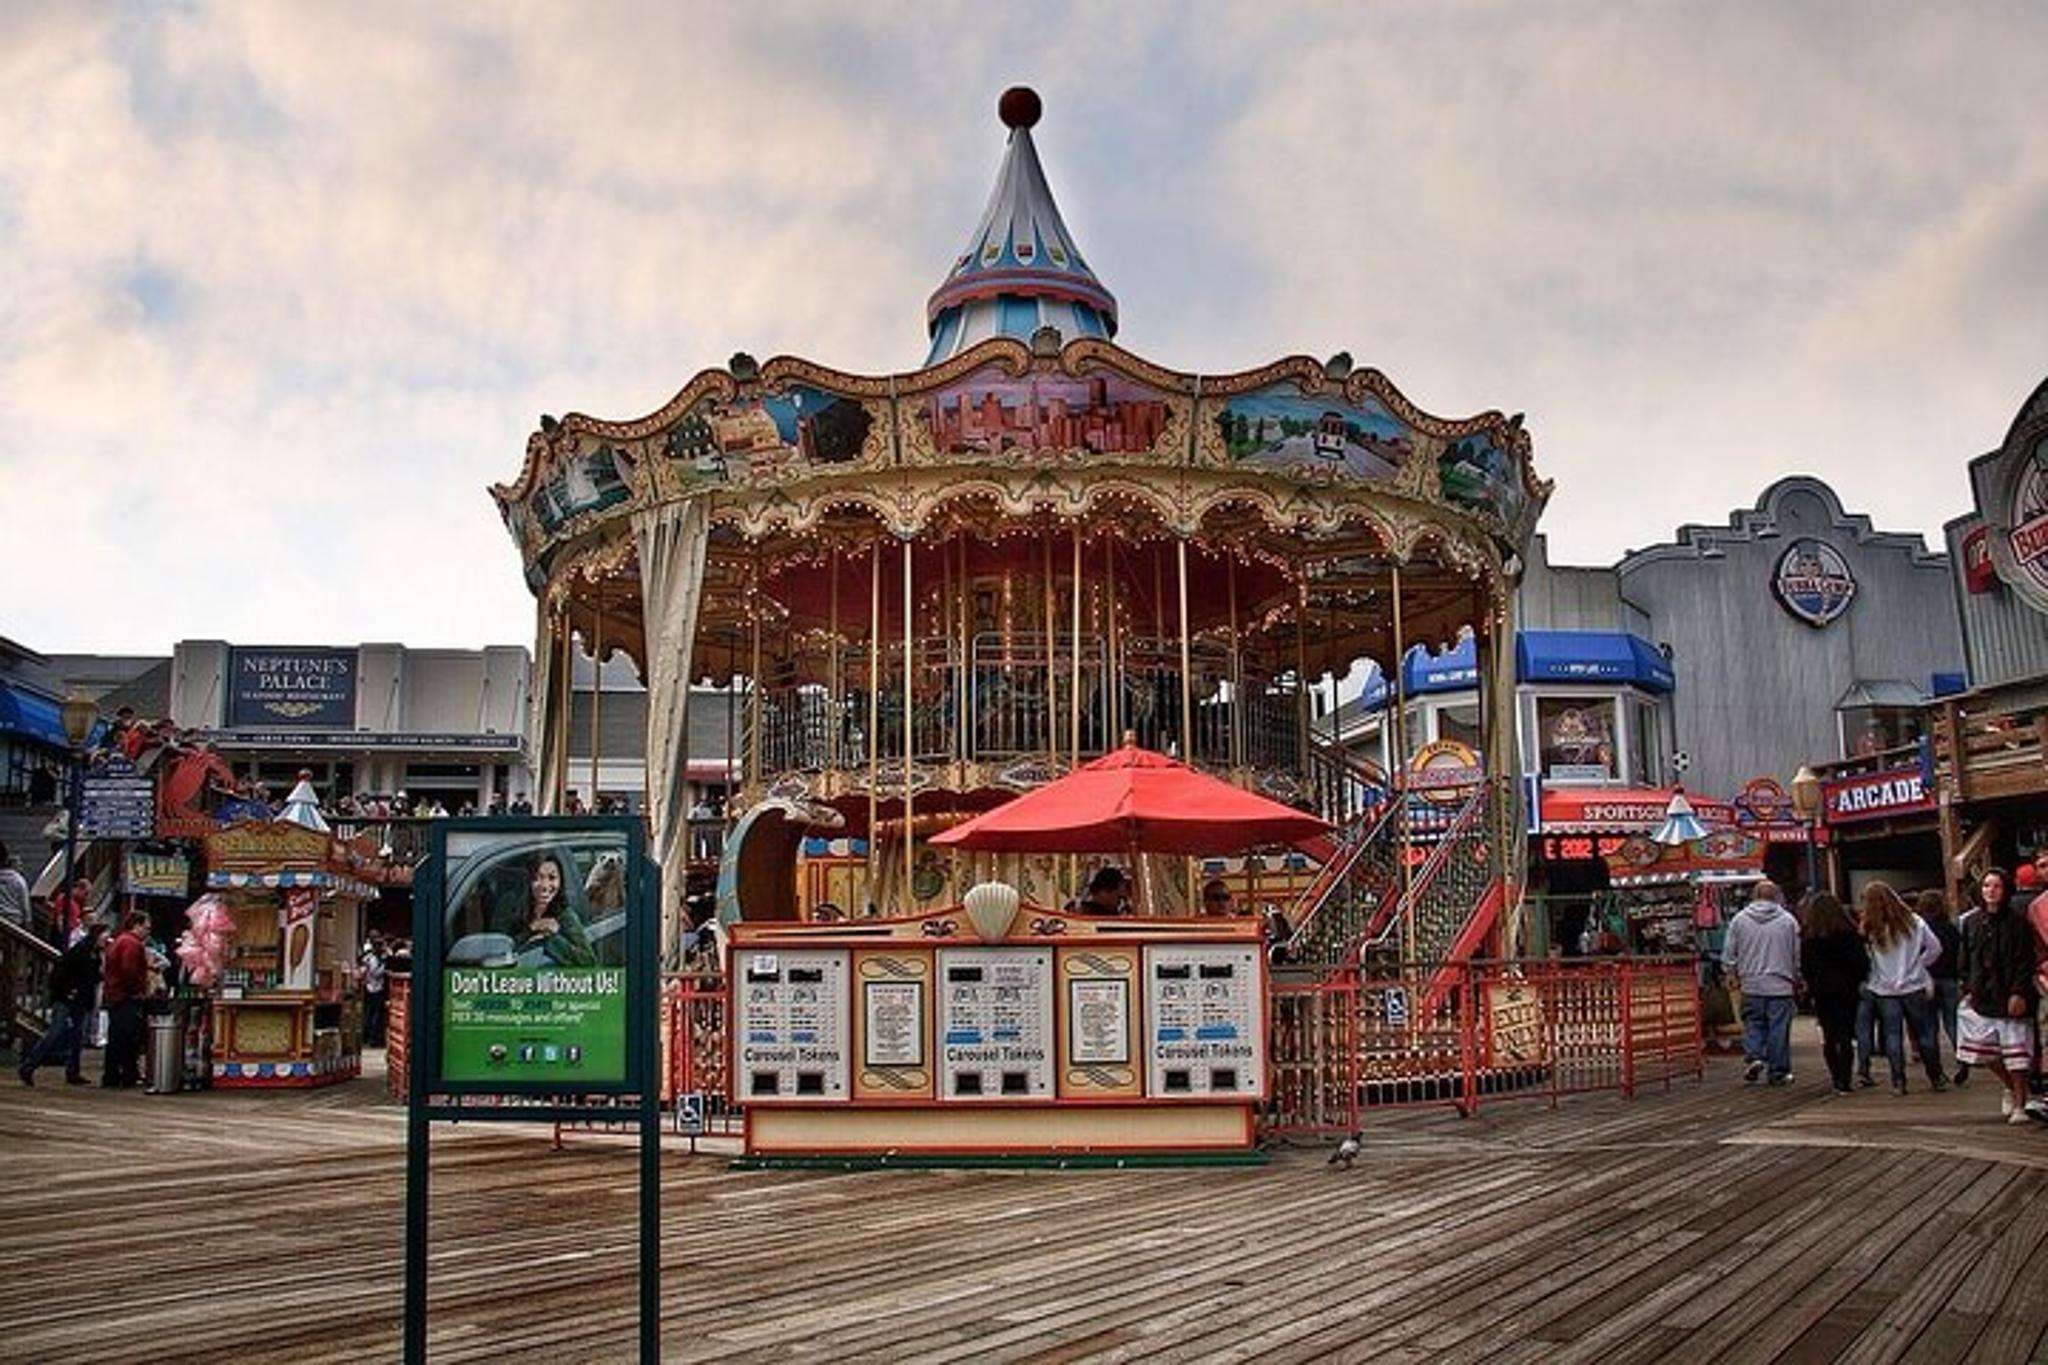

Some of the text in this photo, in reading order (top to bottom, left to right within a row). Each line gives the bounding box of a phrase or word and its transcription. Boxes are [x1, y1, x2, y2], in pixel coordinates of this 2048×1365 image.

[243, 657, 348, 673] NEPTUNE'S
[260, 674, 331, 689] PALACE
[1837, 776, 1924, 812] ARCADE
[451, 971, 618, 994] Don't Leave Without Us!
[745, 1048, 840, 1062] Carousel Tokens
[947, 1047, 1044, 1061] Carousel Tokens
[1157, 1044, 1252, 1059] Carousel Tokens
